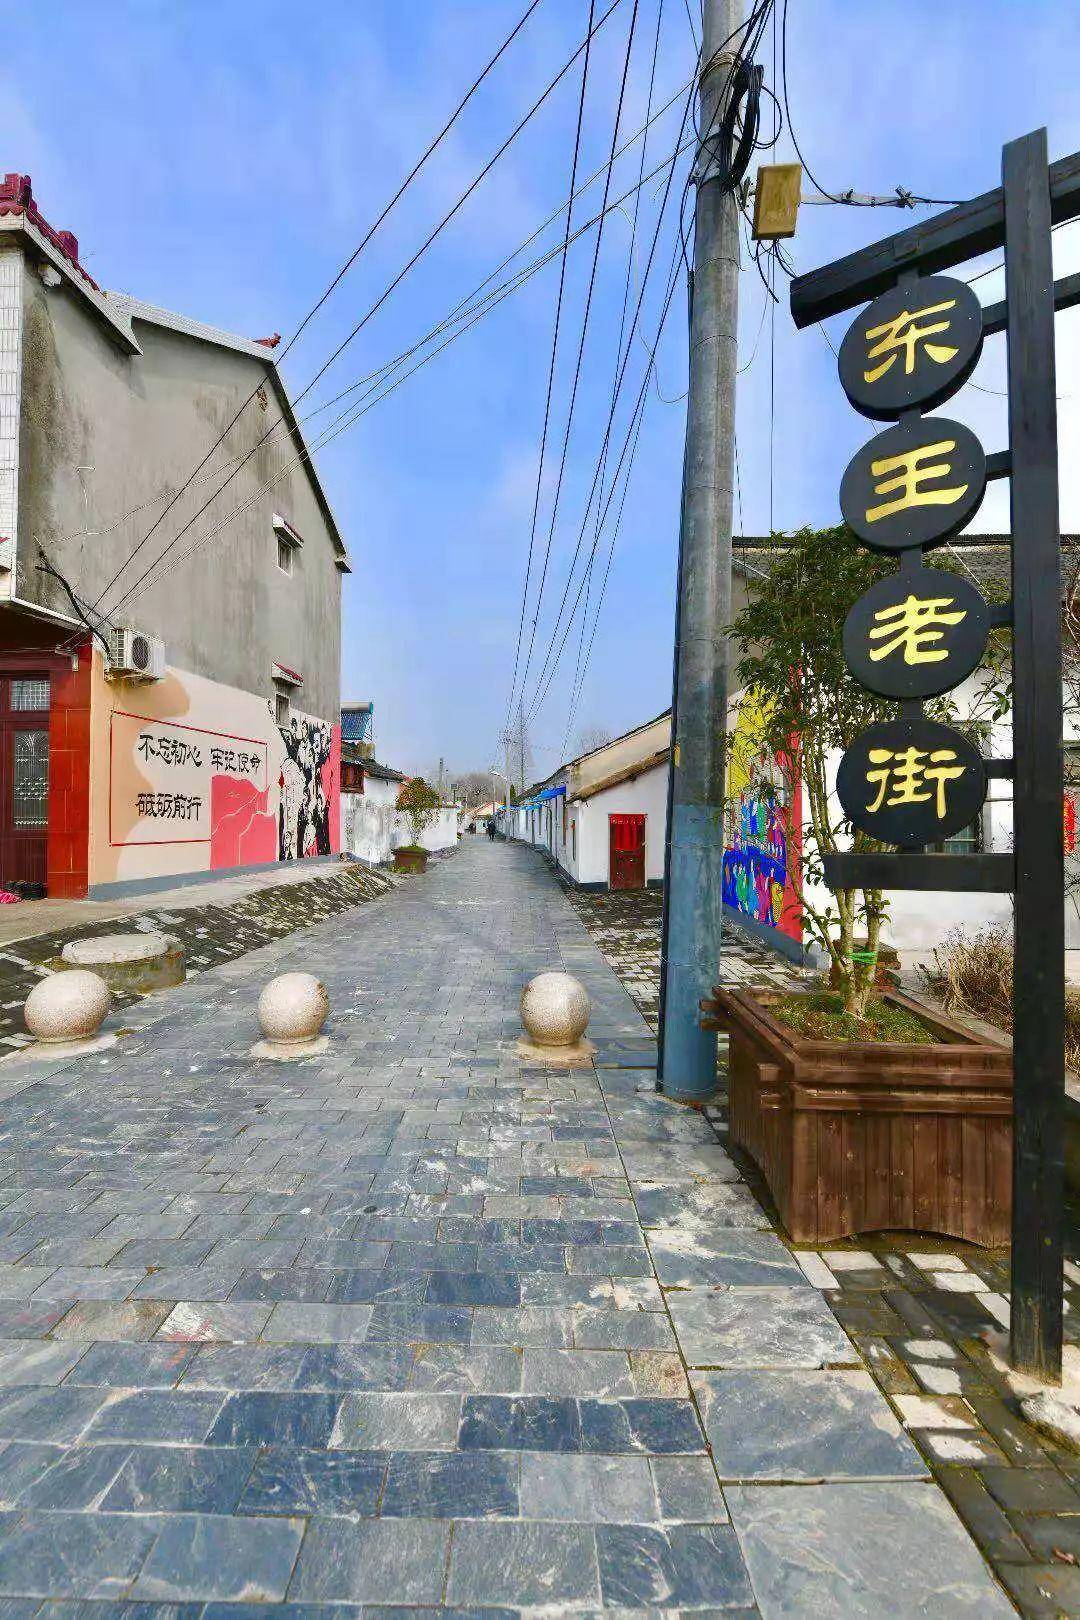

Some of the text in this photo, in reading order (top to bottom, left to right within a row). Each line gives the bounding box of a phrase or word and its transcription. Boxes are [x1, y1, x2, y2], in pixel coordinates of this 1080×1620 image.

[864, 299, 968, 819] 东王老街
[138, 734, 262, 774] 不忘初心 牢记使命
[135, 792, 202, 821] 砥砺前行
